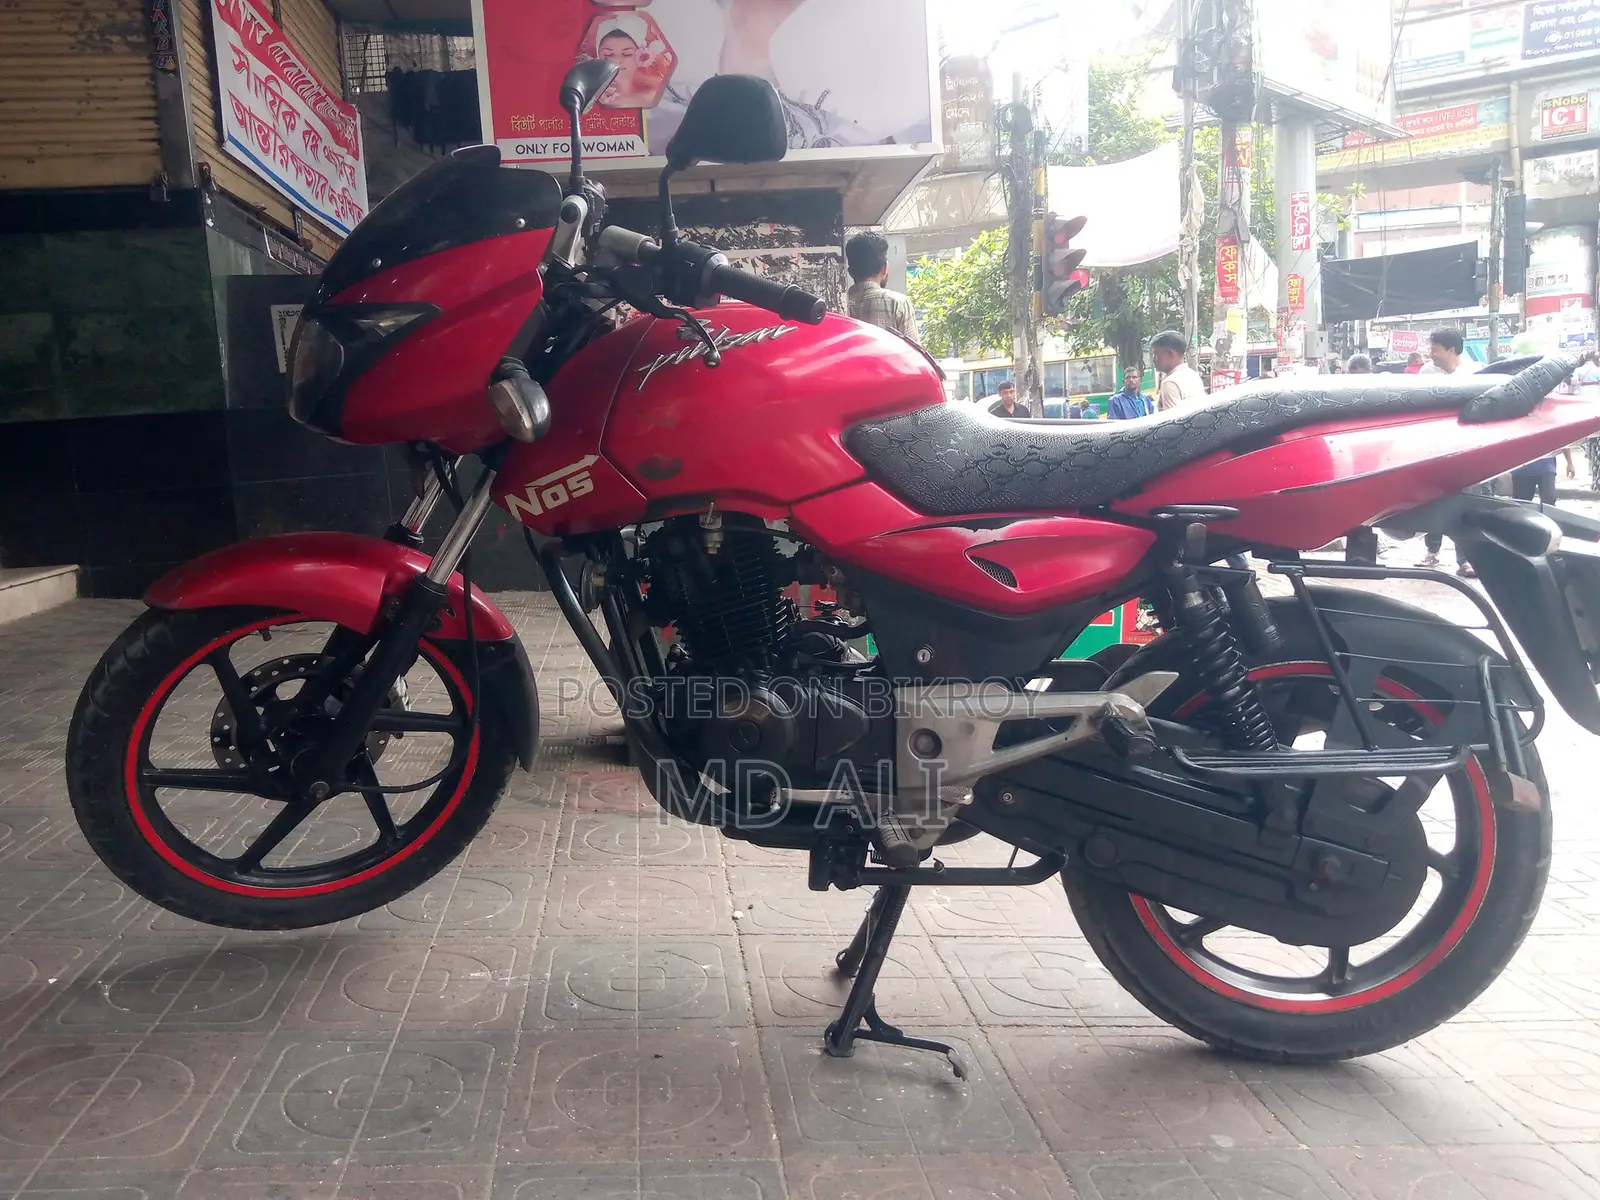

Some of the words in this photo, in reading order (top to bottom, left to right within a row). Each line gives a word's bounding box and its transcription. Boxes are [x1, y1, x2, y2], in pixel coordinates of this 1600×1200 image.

[610, 113, 637, 130] সেন্টার
[515, 143, 548, 155] ONLY
[553, 142, 572, 154] FO
[582, 140, 635, 153] WOMAN
[504, 470, 594, 521] NOS
